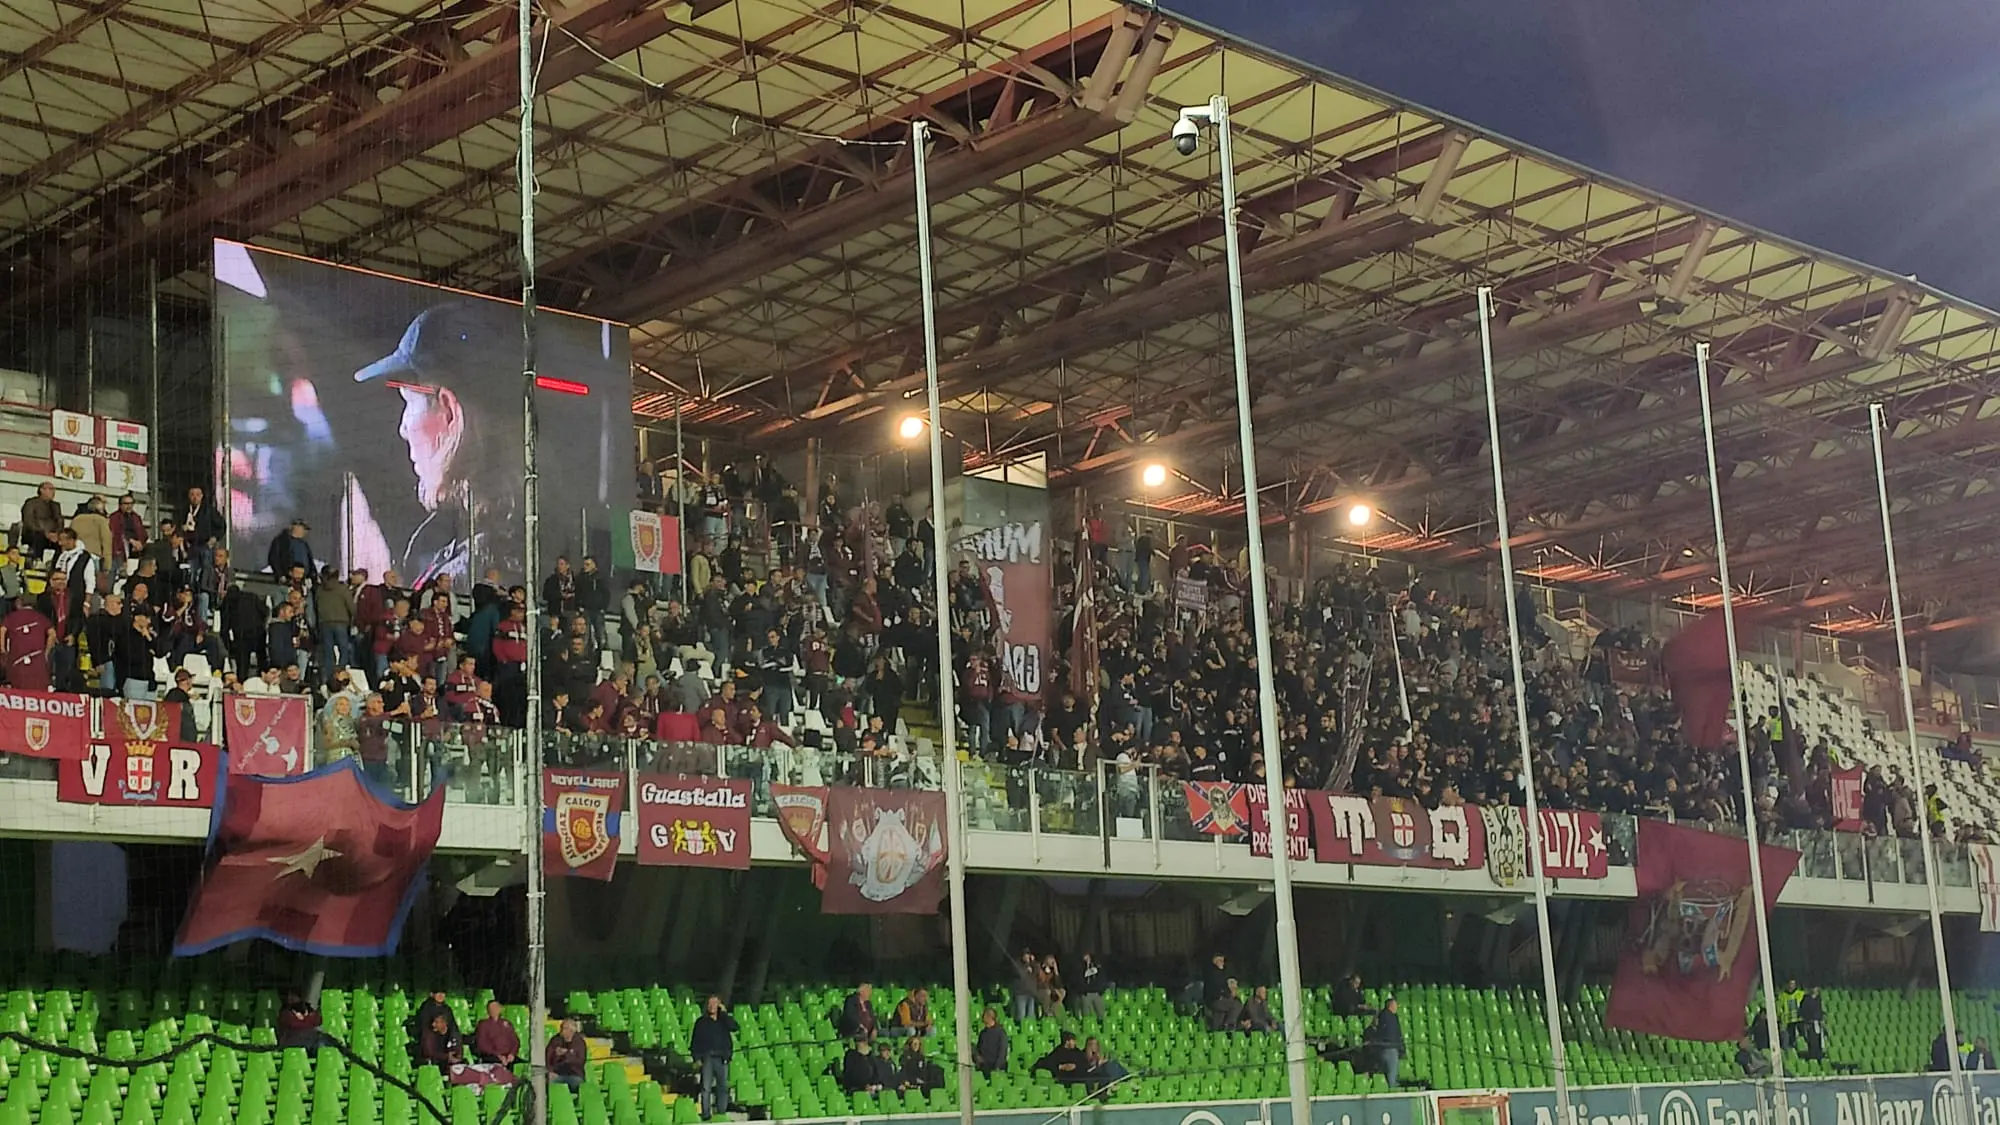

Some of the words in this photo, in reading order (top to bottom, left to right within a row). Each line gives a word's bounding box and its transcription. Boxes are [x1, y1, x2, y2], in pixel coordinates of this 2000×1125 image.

[81, 445, 119, 459] BOSCO
[167, 748, 200, 799] R
[565, 797, 601, 808] CALCIO
[641, 783, 746, 808] Guastalla
